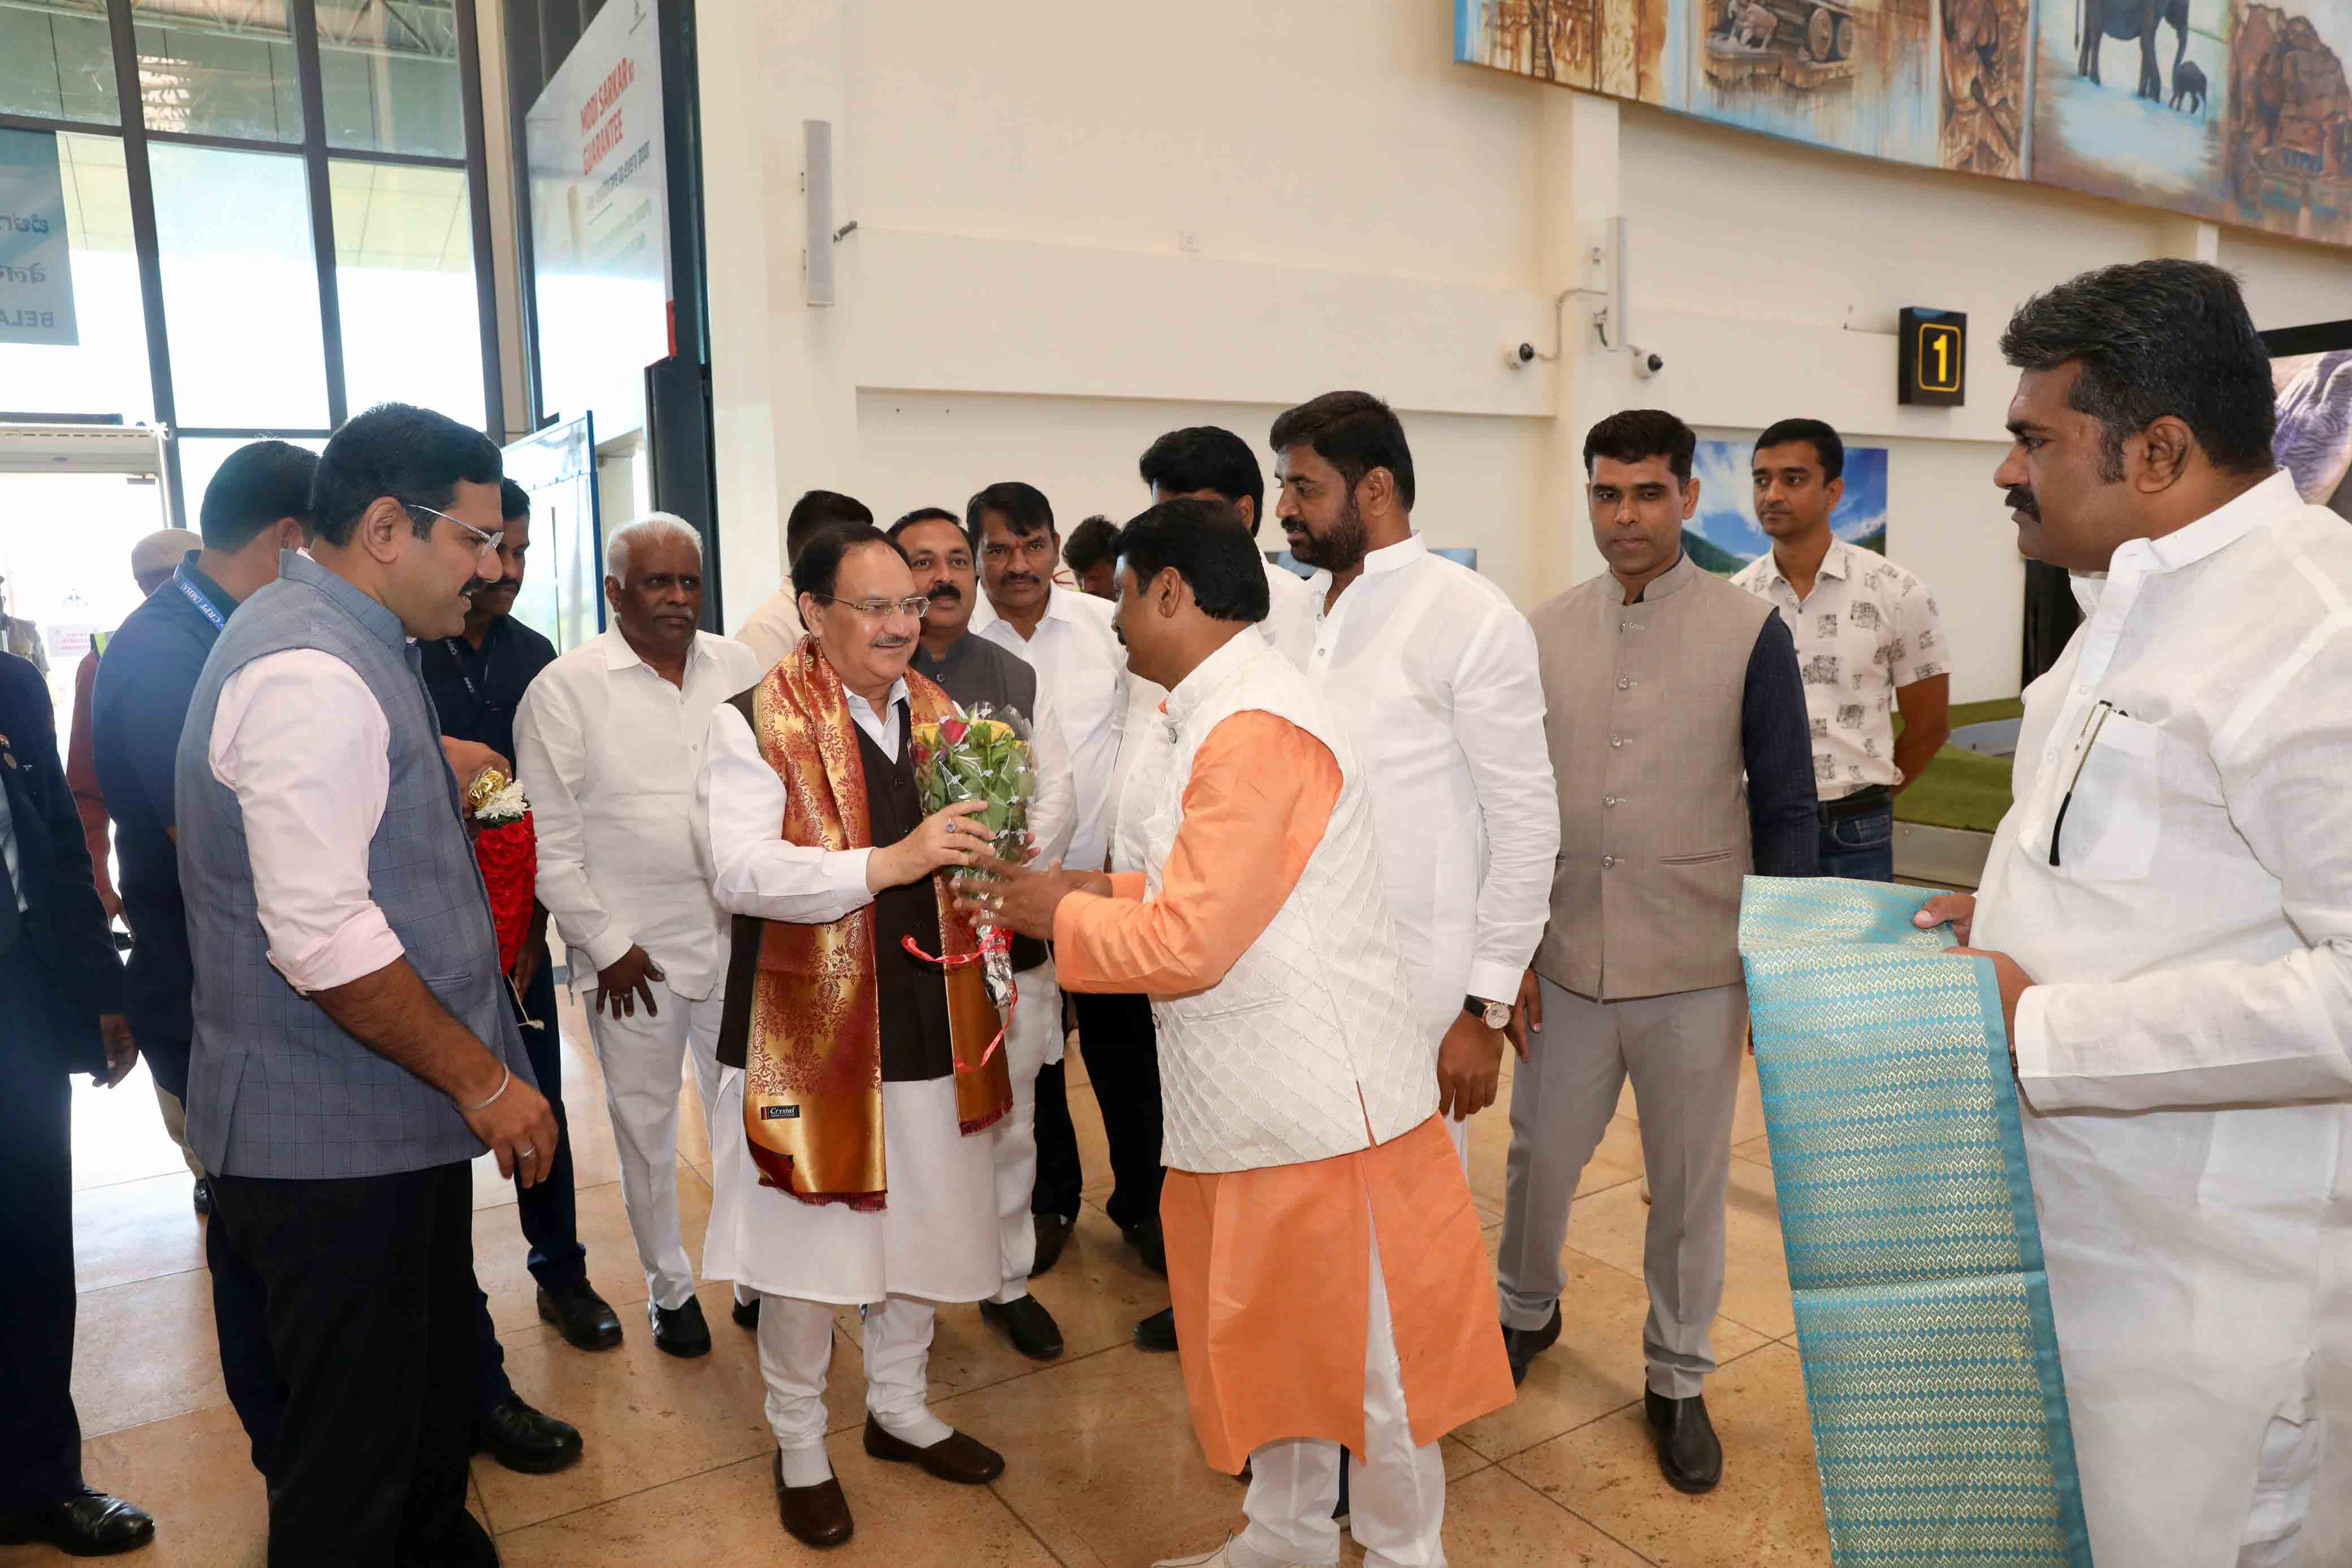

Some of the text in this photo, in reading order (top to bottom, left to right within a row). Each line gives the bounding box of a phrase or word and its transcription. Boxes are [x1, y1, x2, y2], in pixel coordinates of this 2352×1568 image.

[598, 55, 628, 115] SARKAR
[583, 106, 624, 176] GUARANTEE
[1932, 333, 1948, 383] 1
[180, 582, 220, 622] CRPF (MHA)
